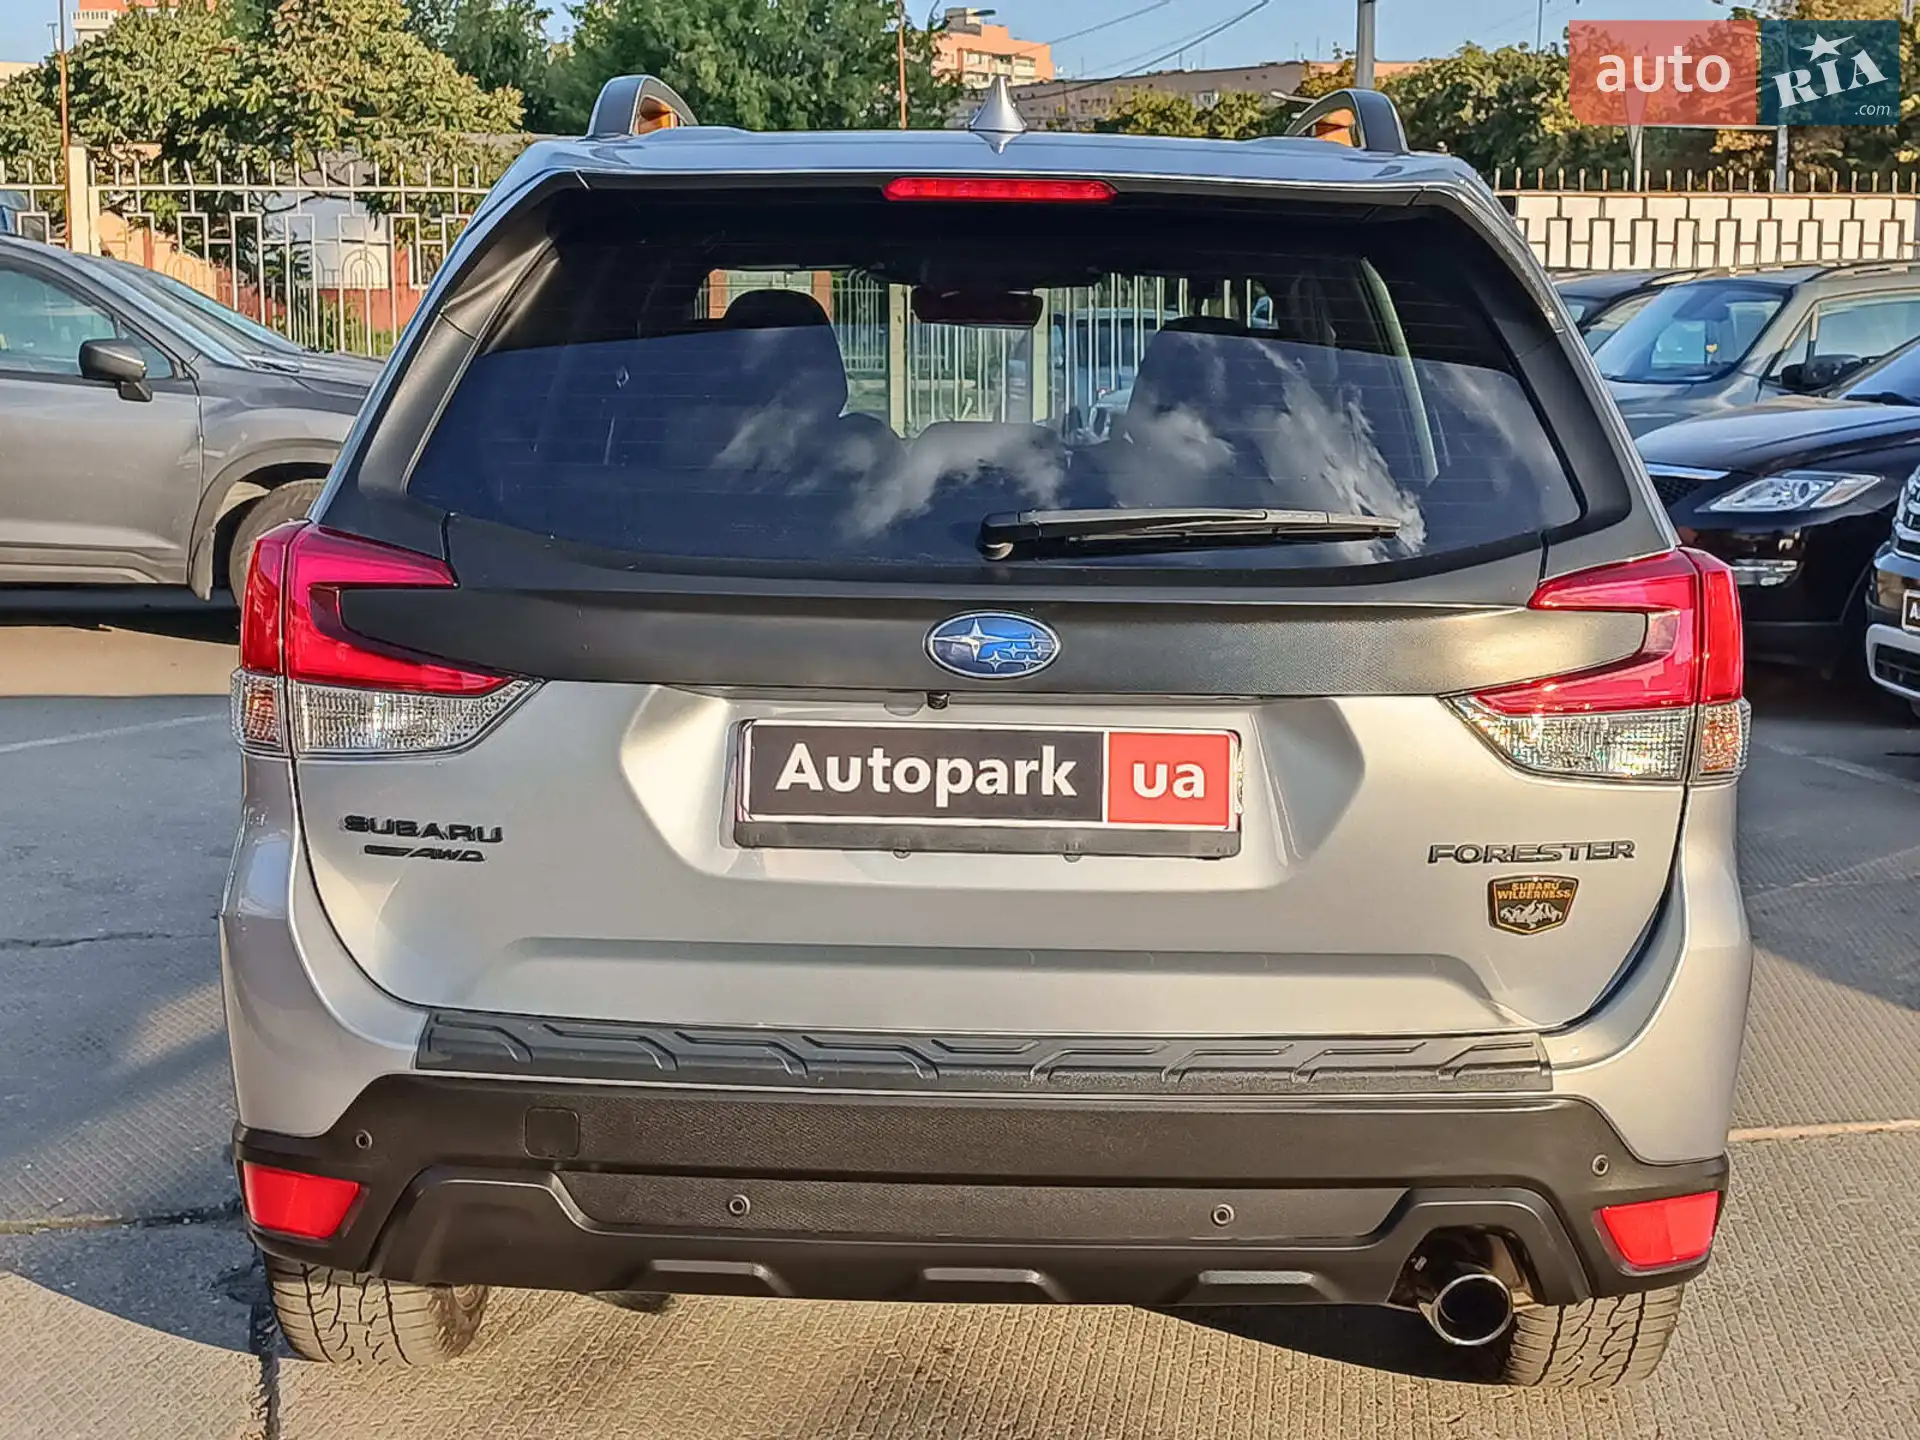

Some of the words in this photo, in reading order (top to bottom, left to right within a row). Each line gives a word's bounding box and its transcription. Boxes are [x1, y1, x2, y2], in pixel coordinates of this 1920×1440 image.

[775, 742, 1078, 808] Autopark
[1132, 761, 1206, 799] ua
[344, 814, 503, 844] SUBARU
[1427, 840, 1636, 865] FORESTER
[1497, 889, 1572, 900] WILDERNESS
[1511, 881, 1560, 891] SUBARU
